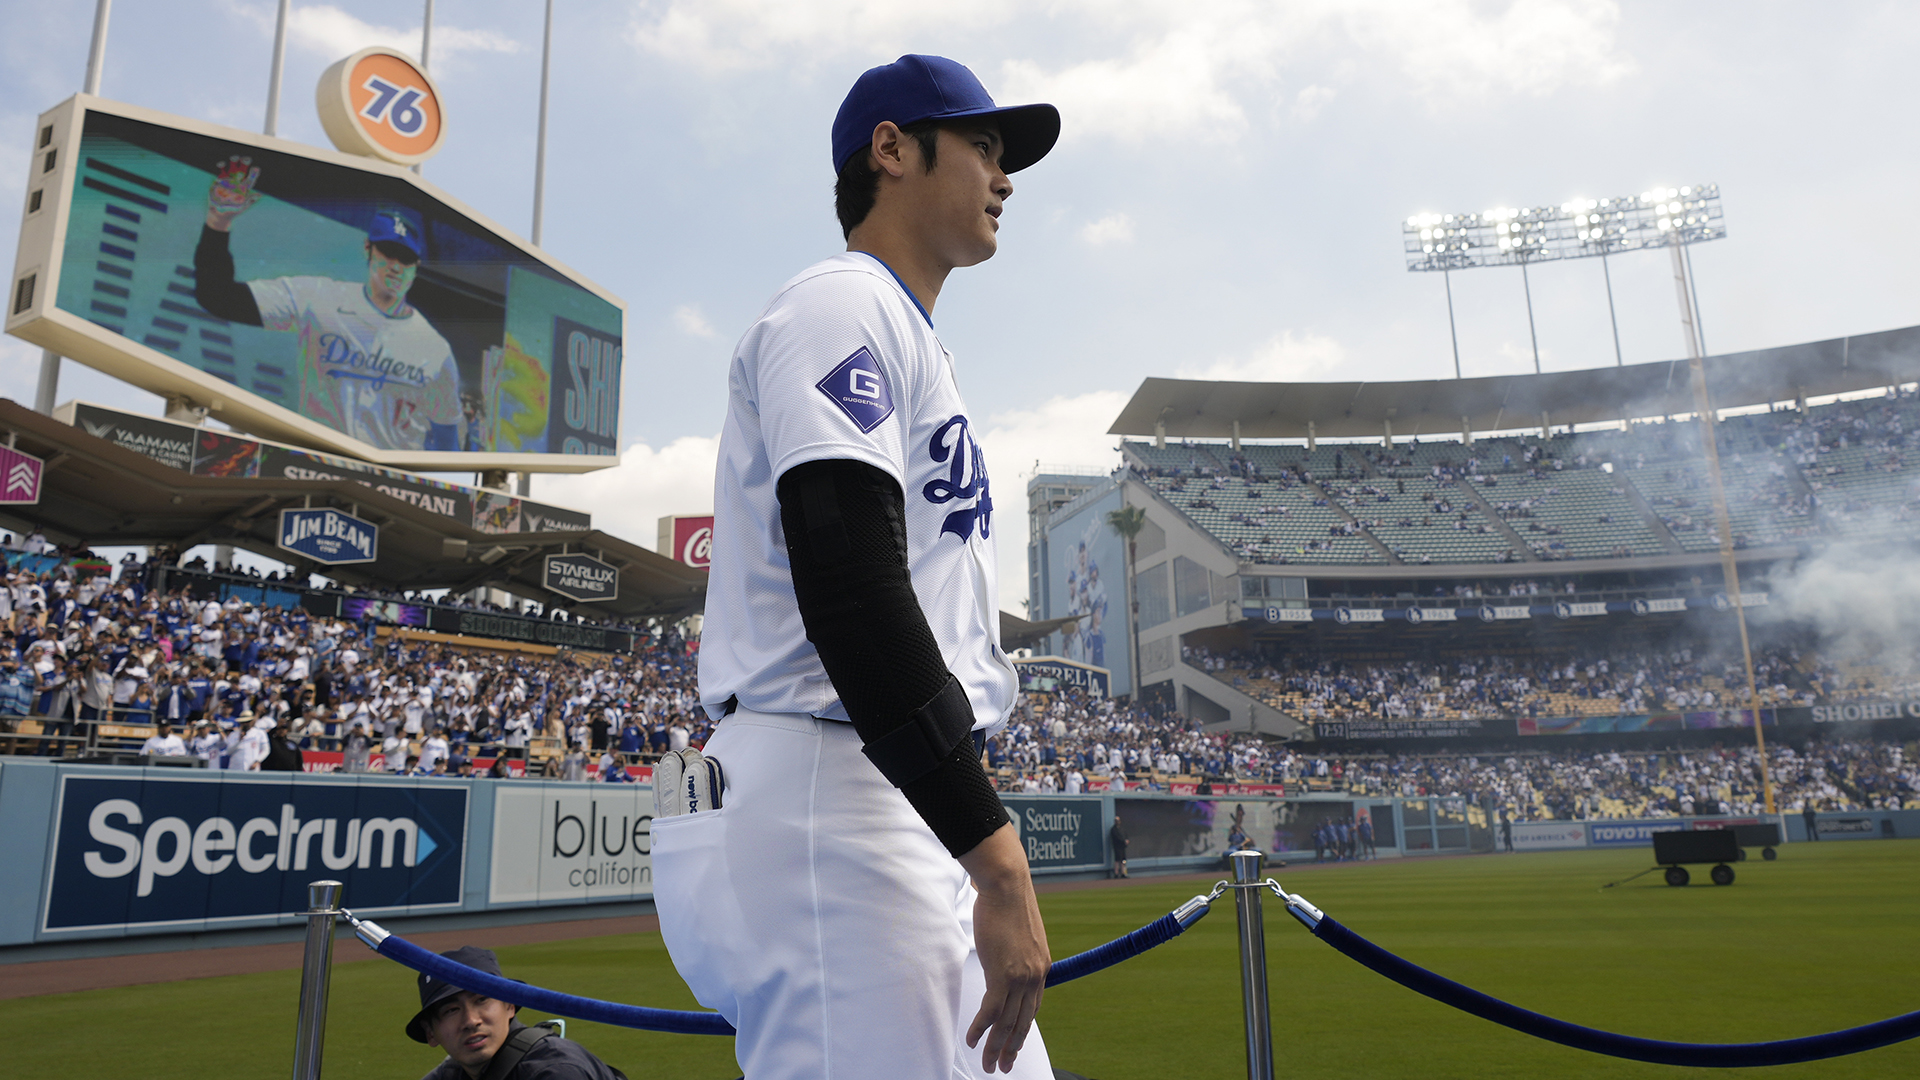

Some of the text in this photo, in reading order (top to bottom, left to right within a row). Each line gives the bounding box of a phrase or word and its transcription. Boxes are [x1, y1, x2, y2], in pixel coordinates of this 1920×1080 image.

[361, 75, 427, 136] 76
[320, 333, 425, 391] Dodgers
[849, 368, 880, 399] G
[158, 449, 192, 463] CASINO
[284, 512, 371, 558] JIM BEAM
[549, 561, 614, 583] STARLUX
[559, 577, 605, 592] AIRLINES
[1811, 701, 1904, 723] SHOHEI
[687, 775, 697, 799] new
[553, 801, 652, 858] blue
[1025, 802, 1081, 837] Security
[1594, 826, 1637, 840] TOYO
[84, 799, 418, 897] Spectrum
[1027, 834, 1075, 861] Benefit
